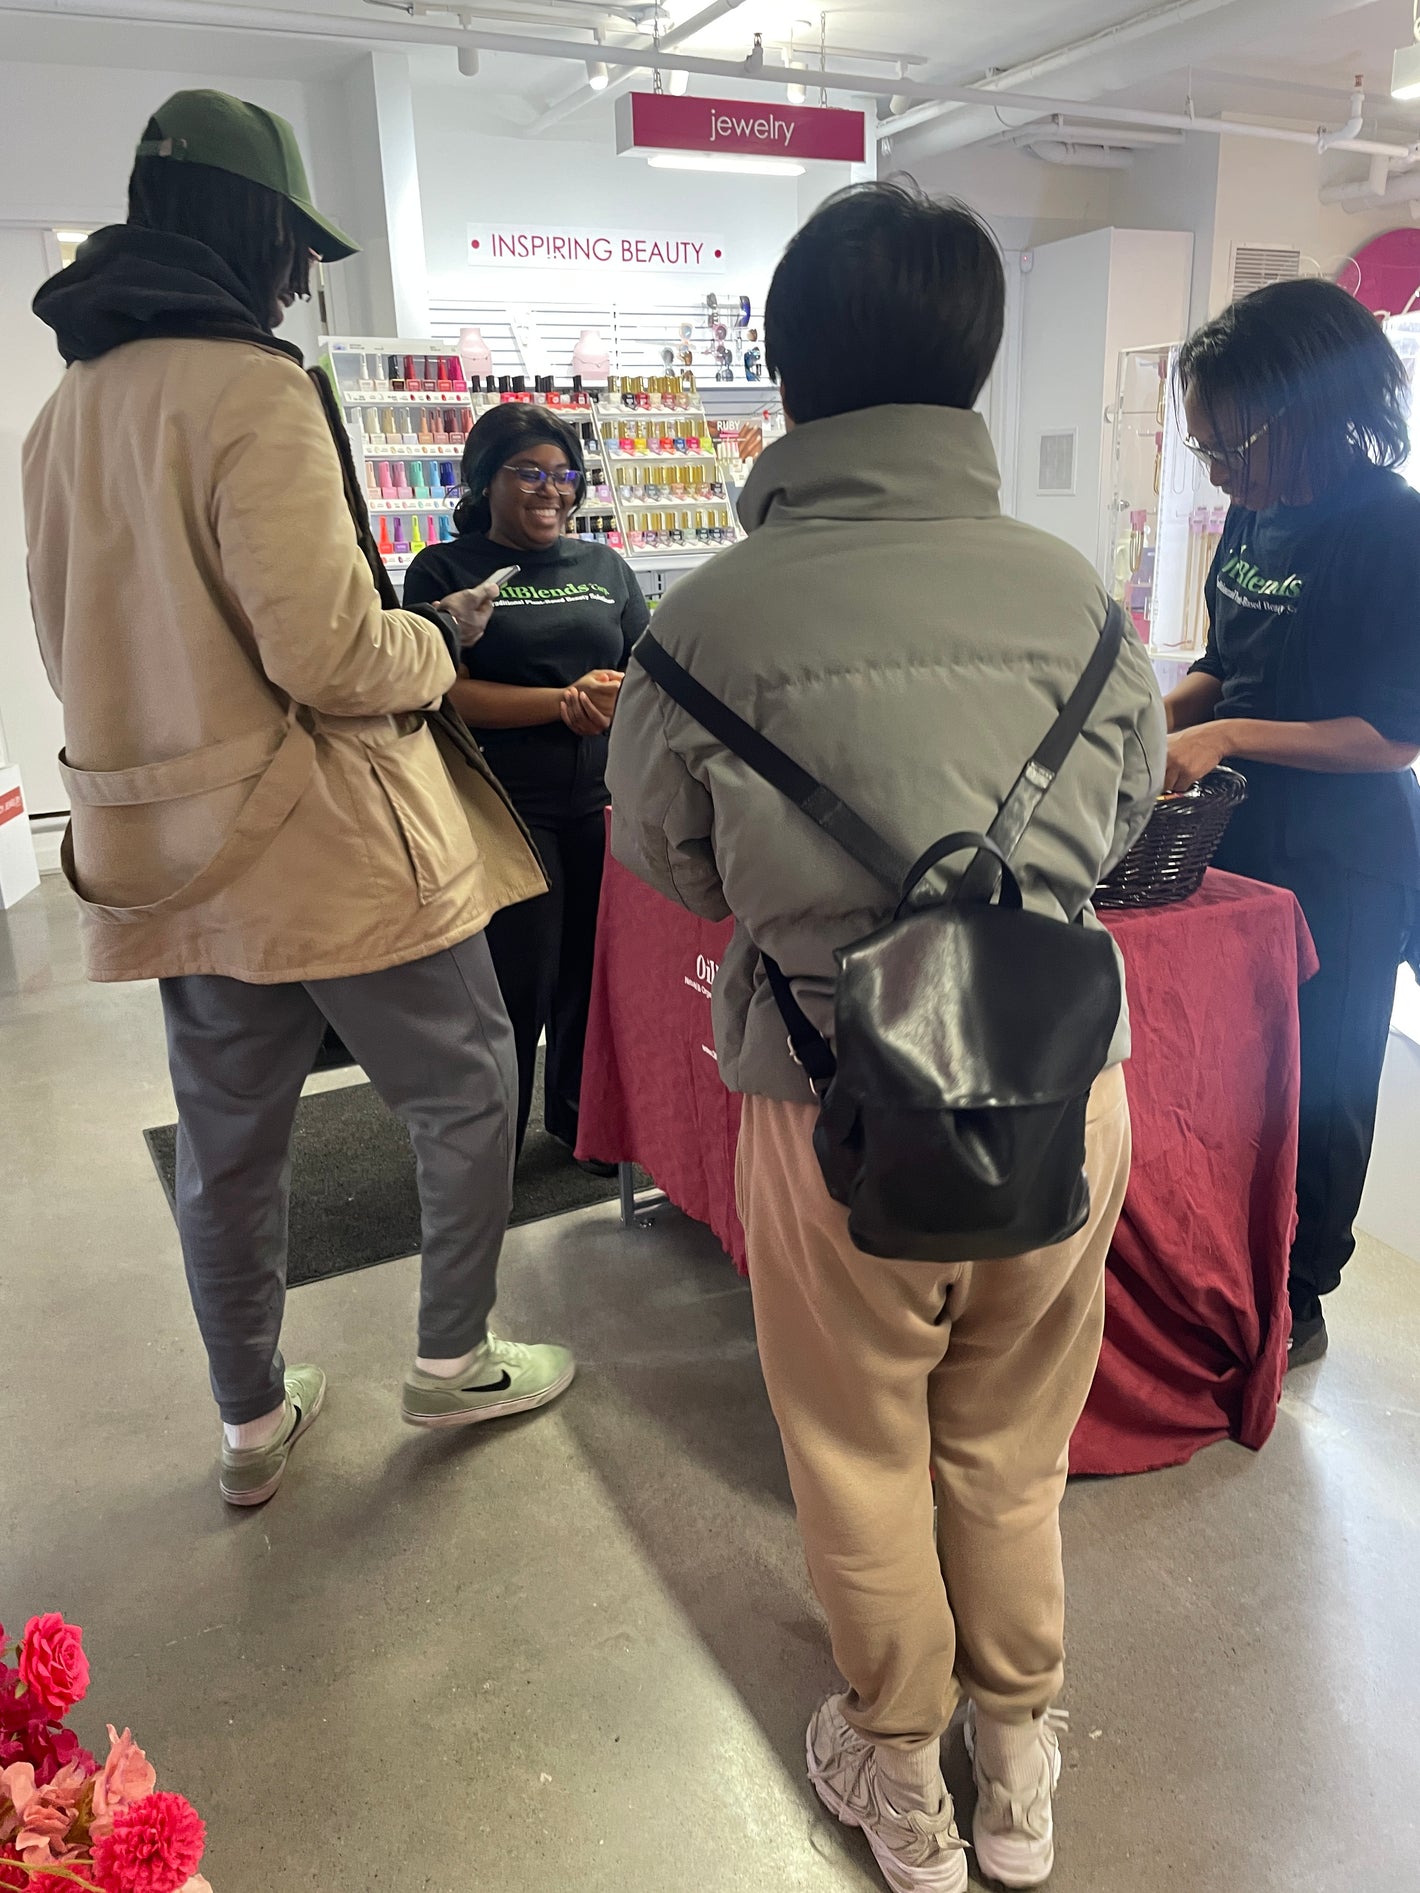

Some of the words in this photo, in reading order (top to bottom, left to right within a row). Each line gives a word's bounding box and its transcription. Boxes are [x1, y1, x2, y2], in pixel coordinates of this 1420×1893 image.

[710, 108, 795, 147] jewelry
[492, 233, 612, 262] INSPIRING
[621, 239, 704, 265] BEAUTY
[717, 420, 740, 431] RUBY
[500, 582, 589, 599] ilBlends
